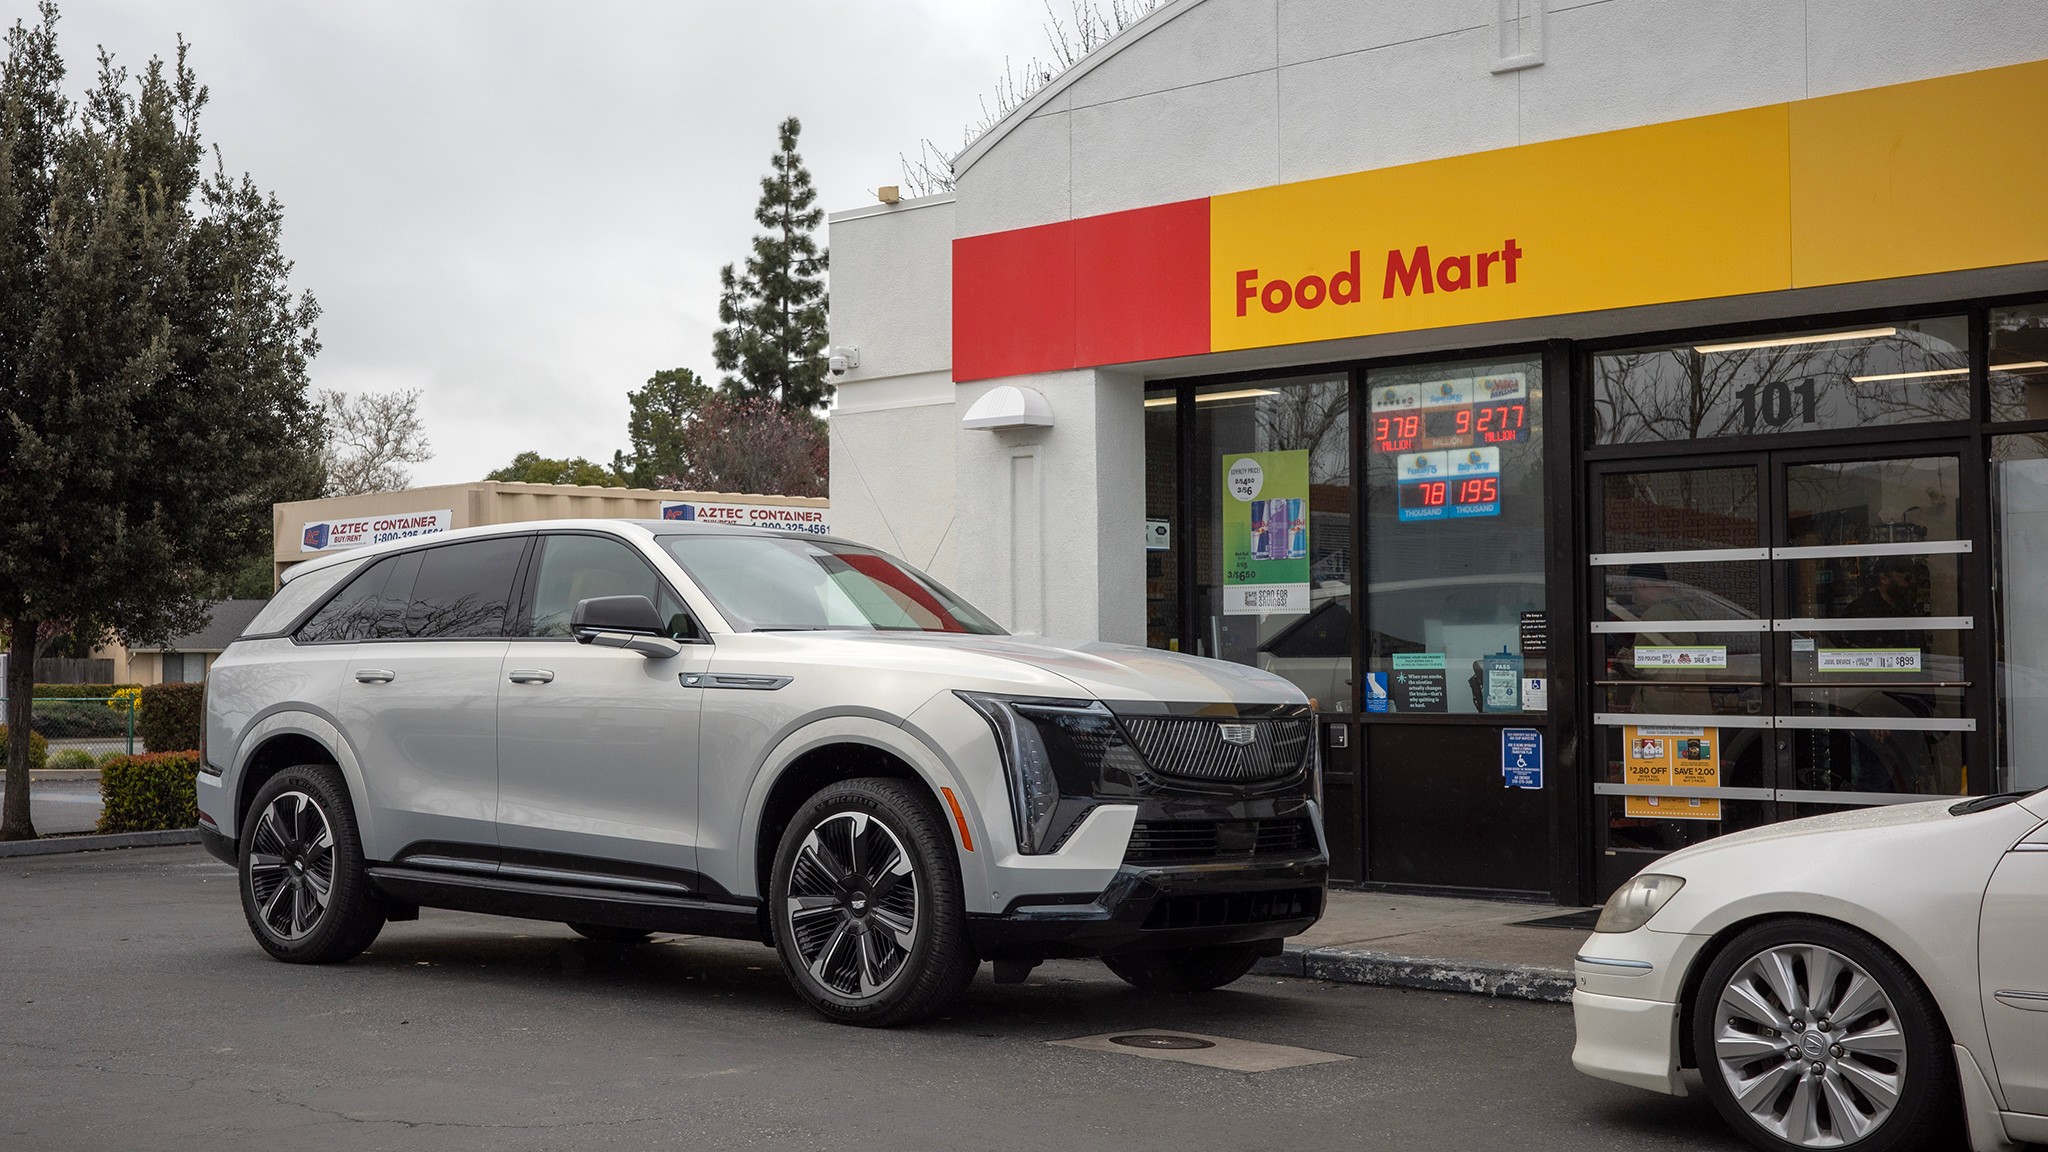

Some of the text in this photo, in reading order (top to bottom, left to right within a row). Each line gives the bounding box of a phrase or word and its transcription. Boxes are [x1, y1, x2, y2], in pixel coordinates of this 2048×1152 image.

[1236, 239, 1522, 317] Food Mart
[1735, 378, 1816, 428] 101
[1456, 410, 1471, 434] 9
[1476, 405, 1524, 432] 277
[1376, 416, 1419, 440] 378
[1432, 436, 1463, 446] MILLION
[1484, 430, 1516, 442] MILLION
[1382, 439, 1412, 451] MILLION
[1420, 482, 1446, 505] 78
[1460, 478, 1496, 503] 195
[698, 507, 822, 522] AZTEC CONTAINER
[1405, 508, 1442, 517] THOUSAND
[1456, 504, 1494, 514] THOUSAND
[330, 516, 437, 536] AZTEC CONTAINER
[334, 534, 362, 544] BUY/RENT
[1258, 590, 1288, 598] SCAN FOR
[828, 796, 877, 808] MICHELIN
